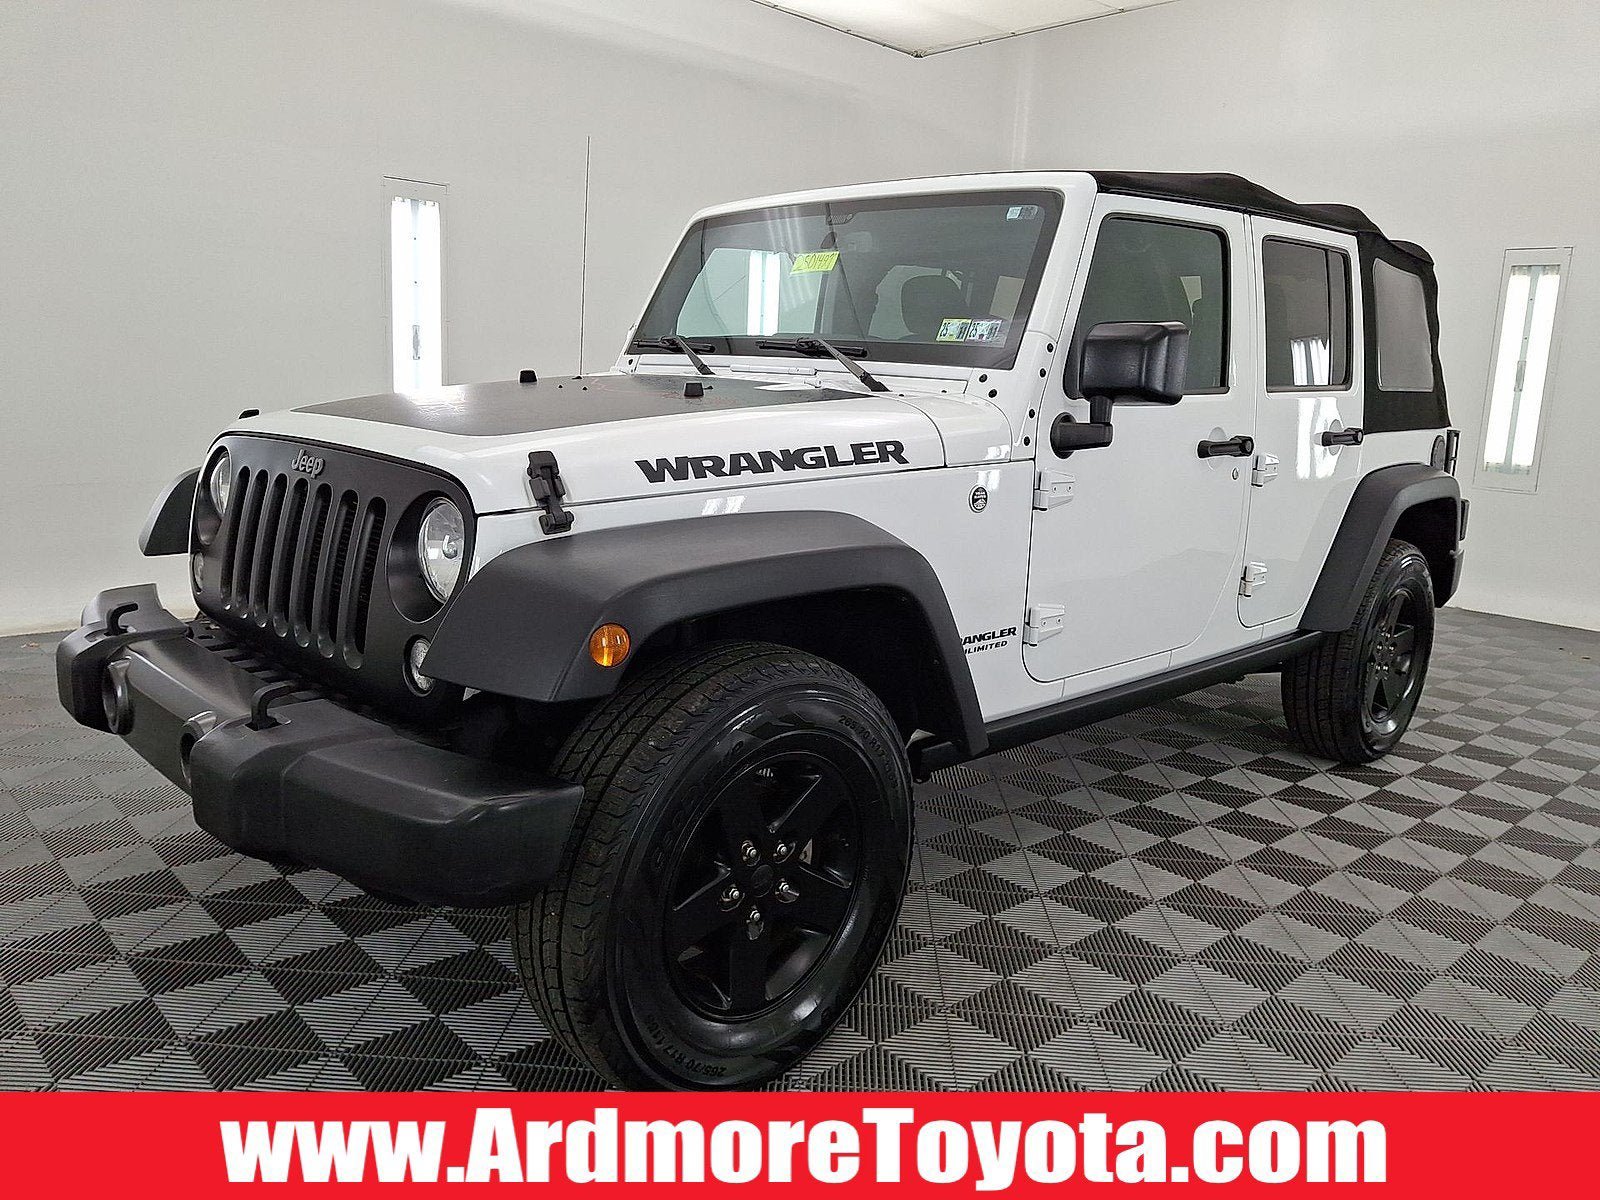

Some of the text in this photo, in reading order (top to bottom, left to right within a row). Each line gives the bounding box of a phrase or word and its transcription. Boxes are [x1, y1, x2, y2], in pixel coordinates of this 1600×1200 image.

[291, 449, 325, 479] Jeep
[635, 440, 909, 483] WRANGLER
[961, 626, 1017, 646] ANGLER
